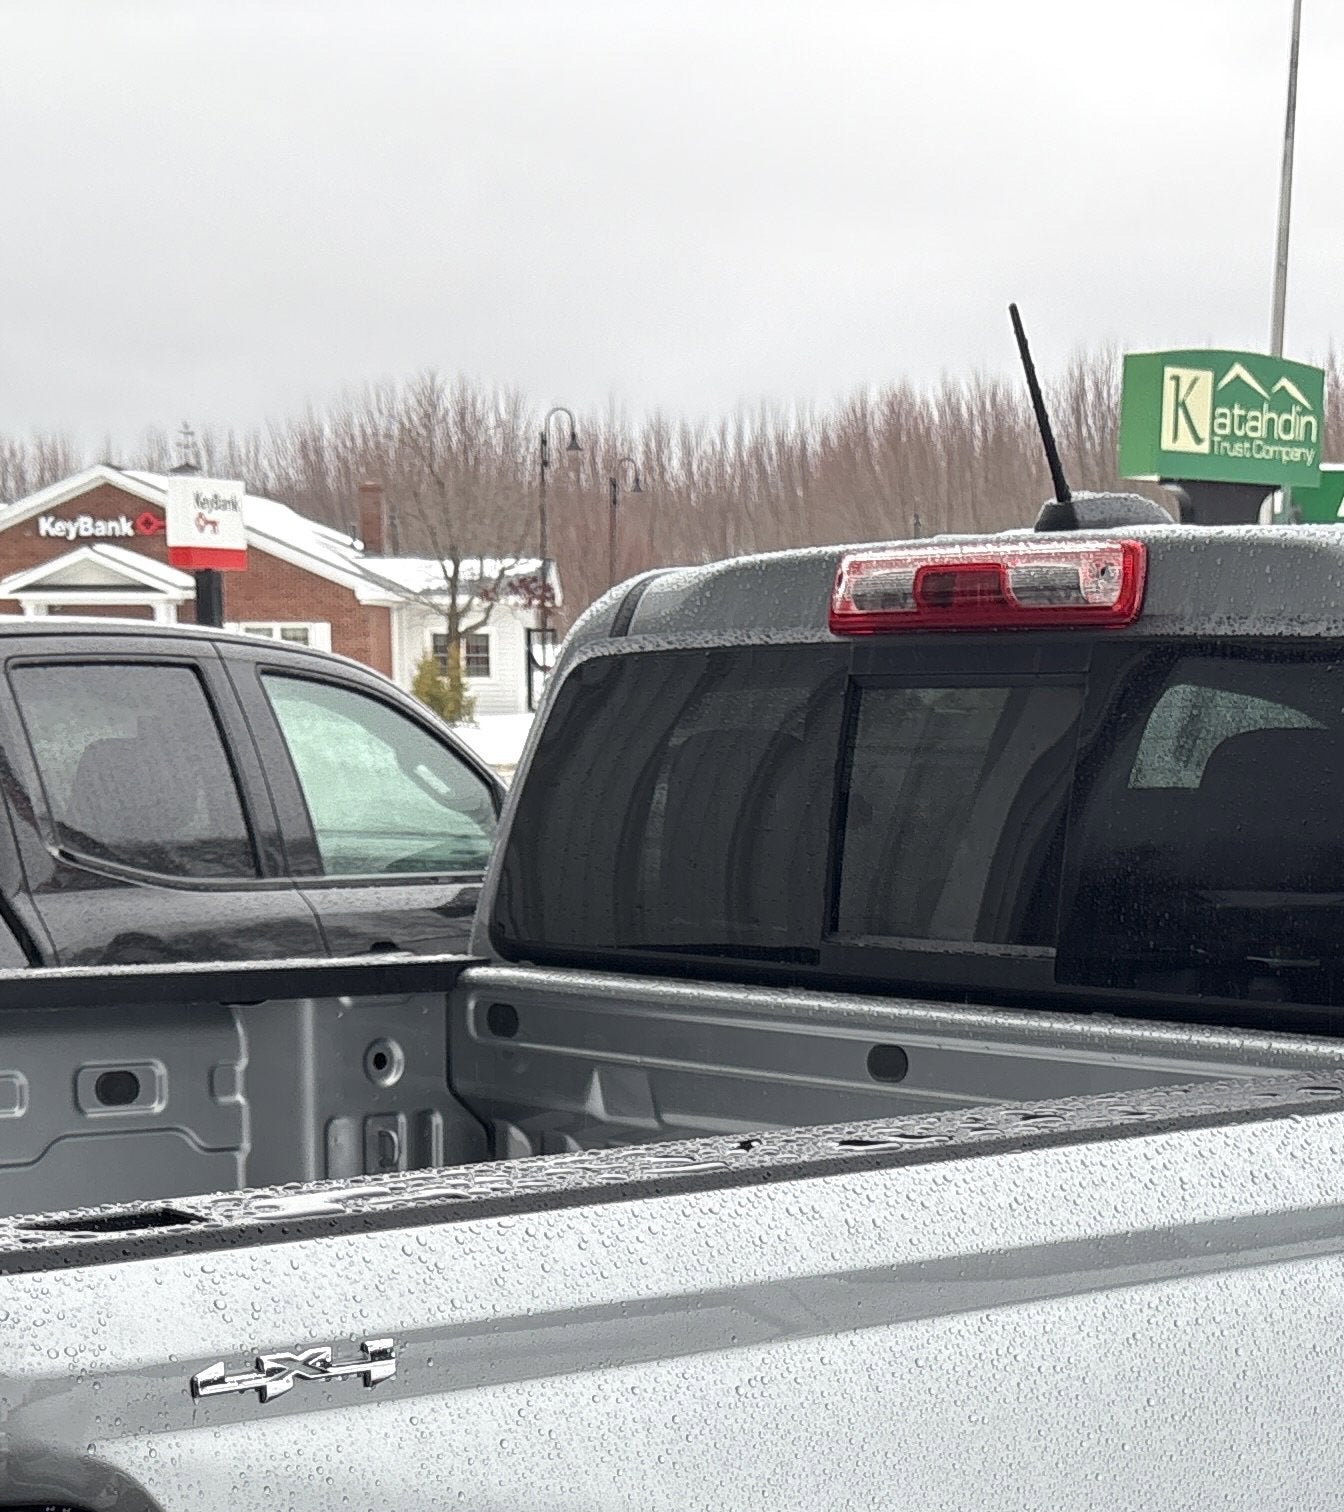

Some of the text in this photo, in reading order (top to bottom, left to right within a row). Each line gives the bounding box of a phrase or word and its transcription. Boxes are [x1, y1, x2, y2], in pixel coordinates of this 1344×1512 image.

[1169, 373, 1318, 447] Katahdin
[1212, 438, 1316, 466] Trust Company
[193, 491, 241, 513] KeyBank
[37, 514, 135, 541] KeyBank
